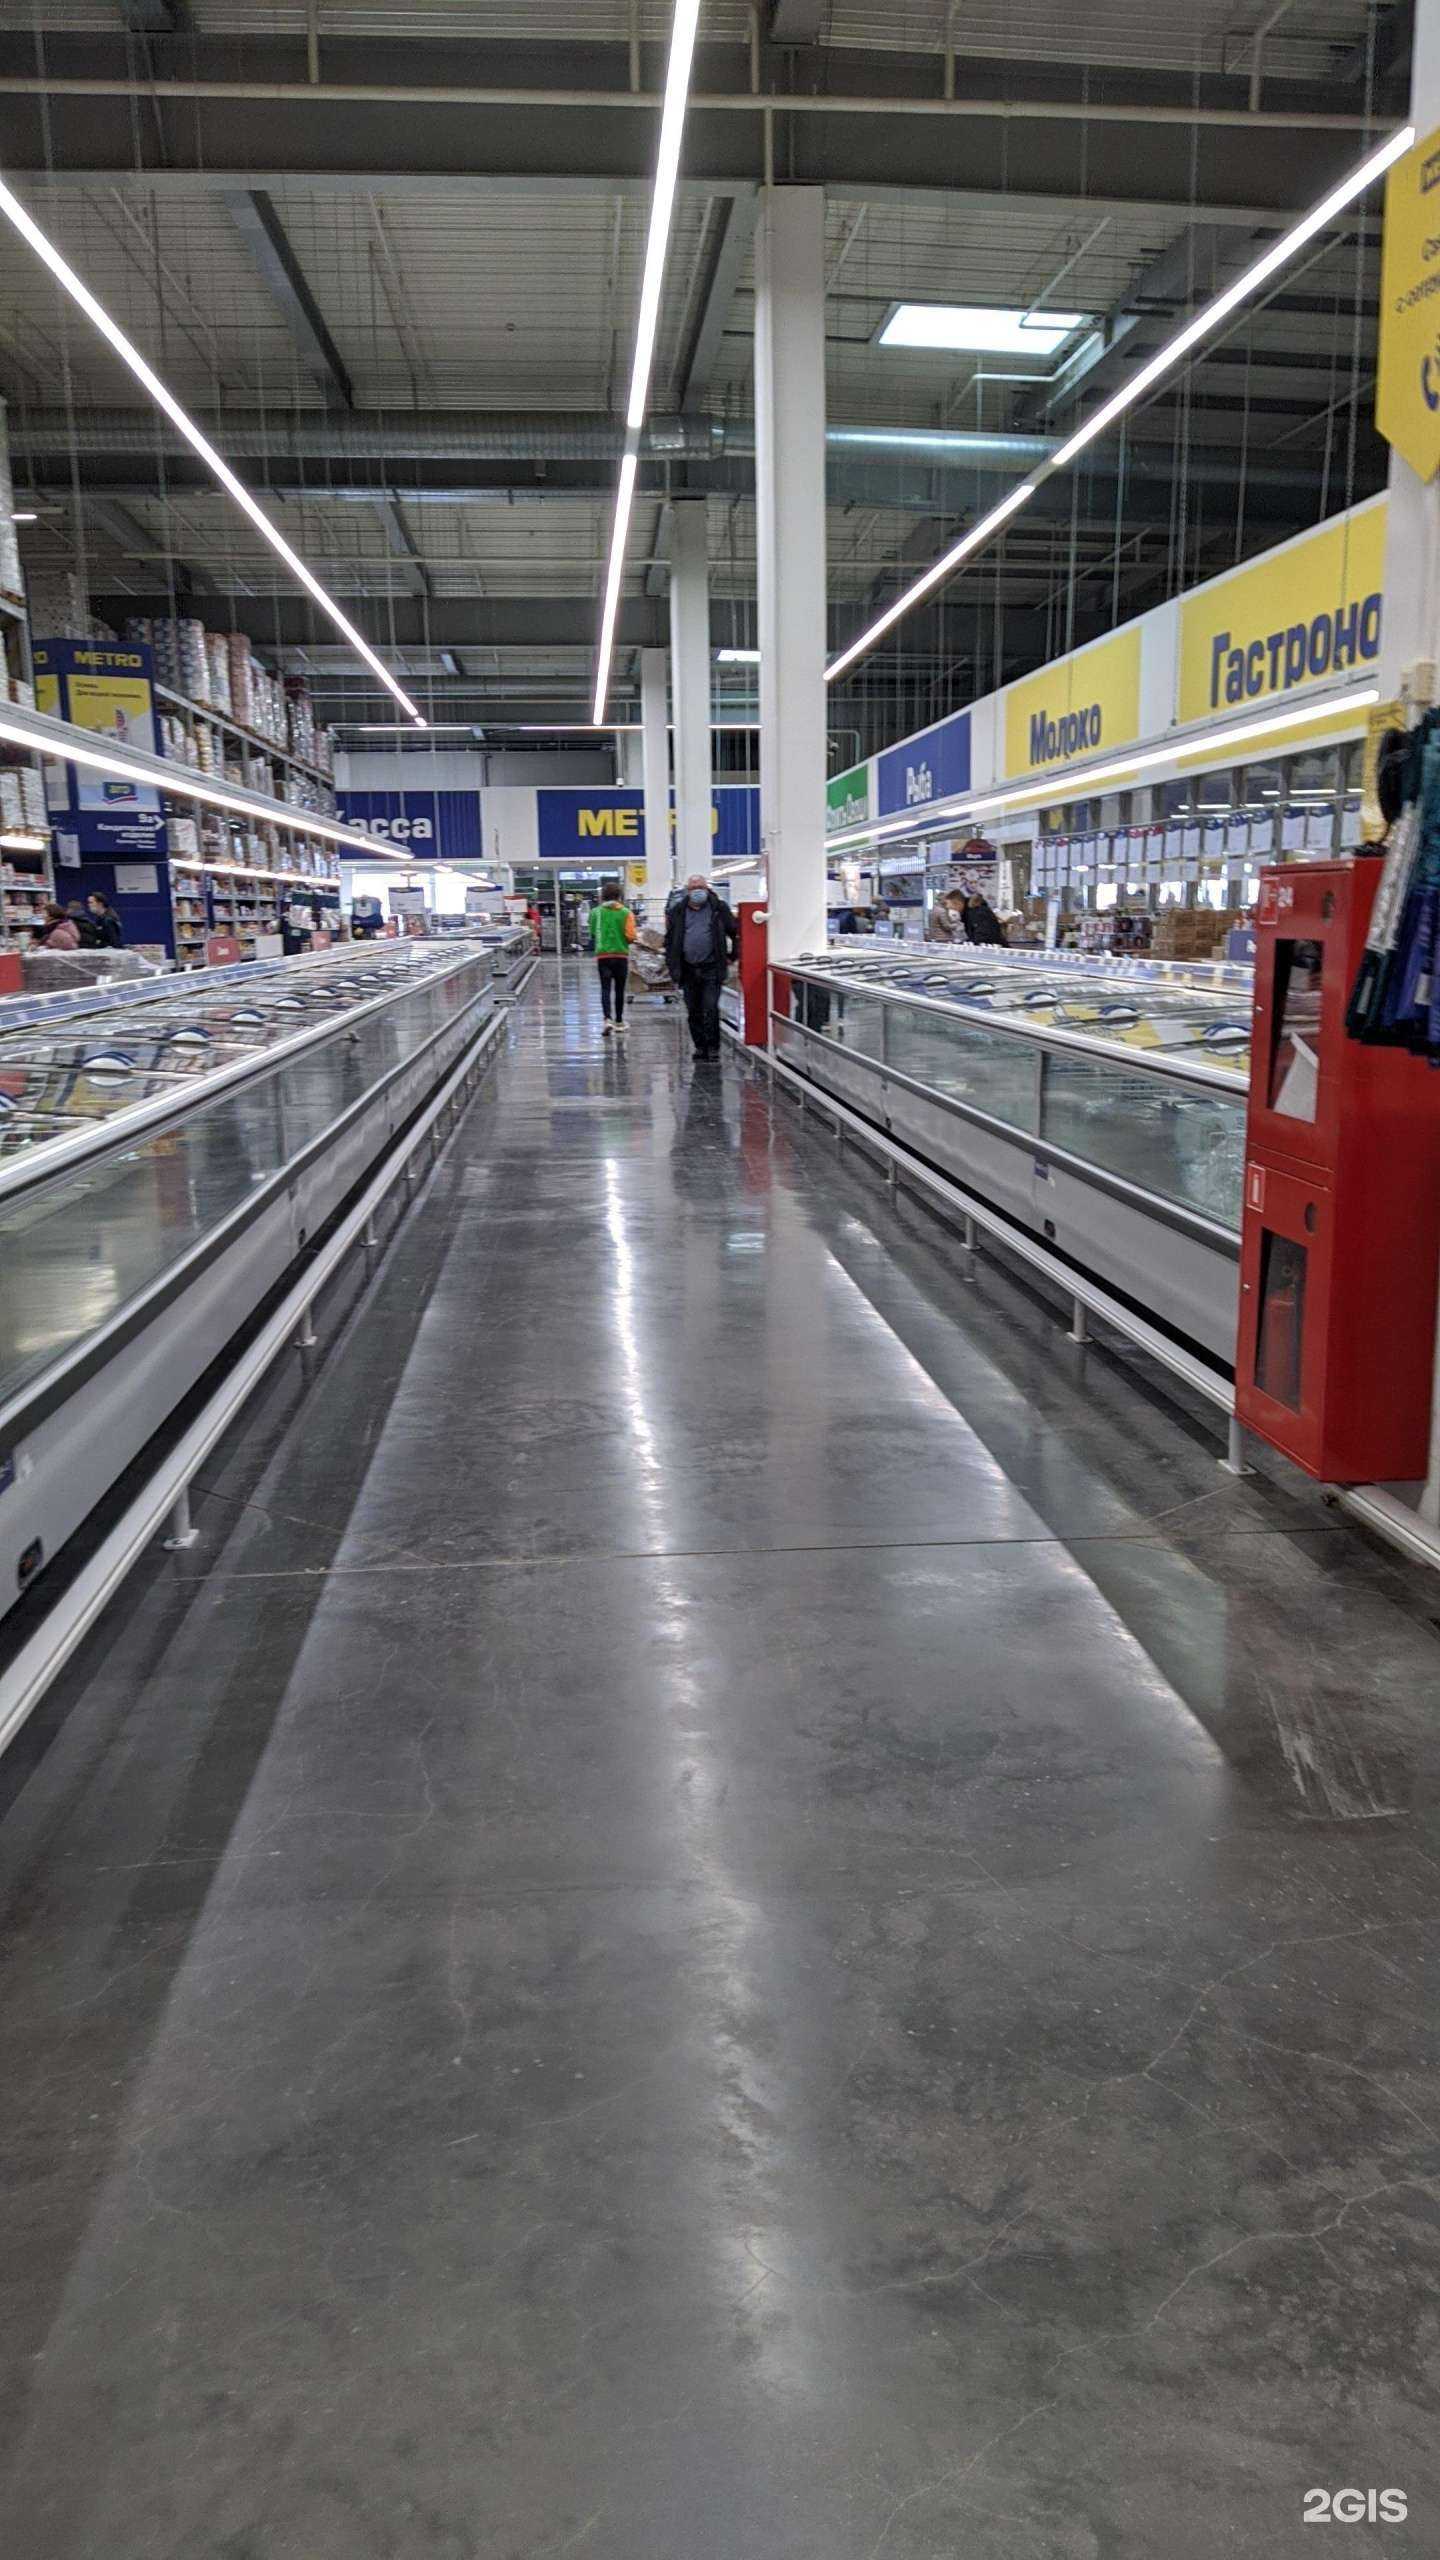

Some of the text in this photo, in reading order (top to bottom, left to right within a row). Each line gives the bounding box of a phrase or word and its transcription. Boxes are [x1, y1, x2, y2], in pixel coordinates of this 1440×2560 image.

[74, 651, 142, 667] METRO
[1030, 703, 1101, 766] Молоко
[336, 810, 433, 839] асса
